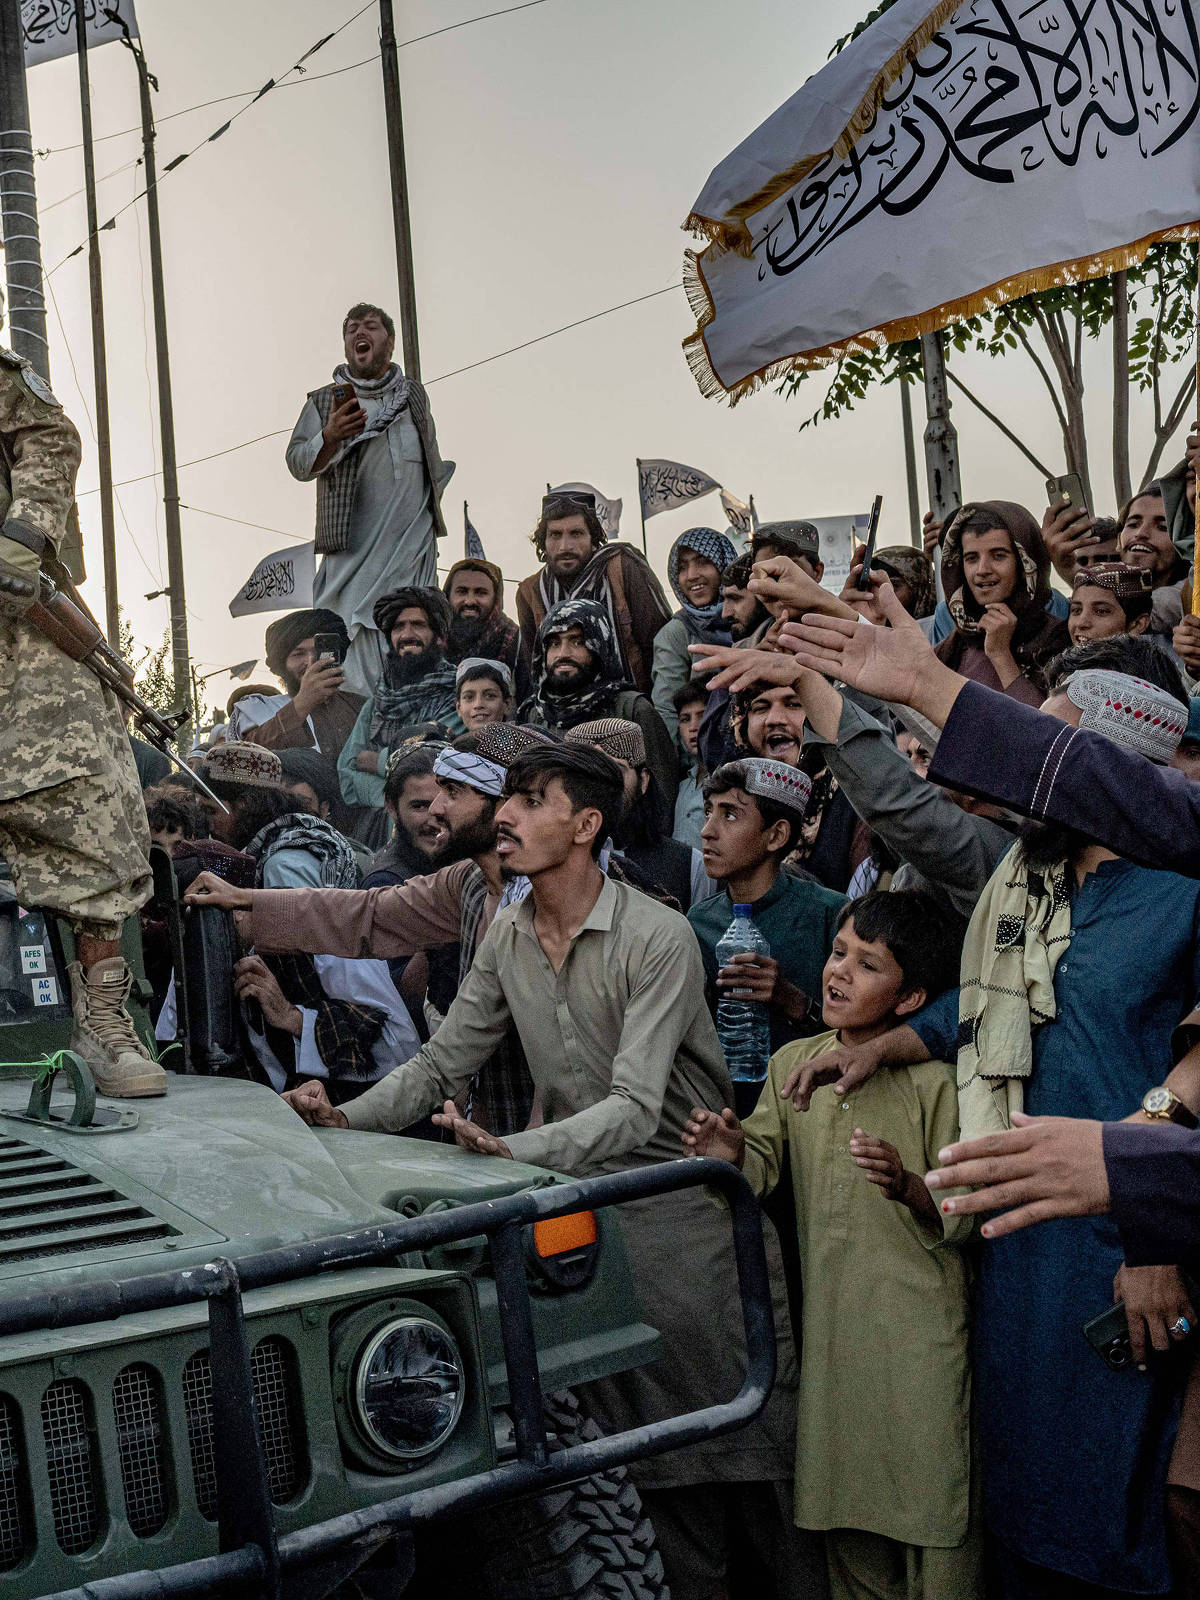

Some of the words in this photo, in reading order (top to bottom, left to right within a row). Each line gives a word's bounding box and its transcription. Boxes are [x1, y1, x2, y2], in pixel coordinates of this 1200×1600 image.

[24, 949, 41, 958] AFES
[29, 960, 39, 969] OK
[38, 979, 50, 989] AC
[39, 993, 52, 1003] OK
